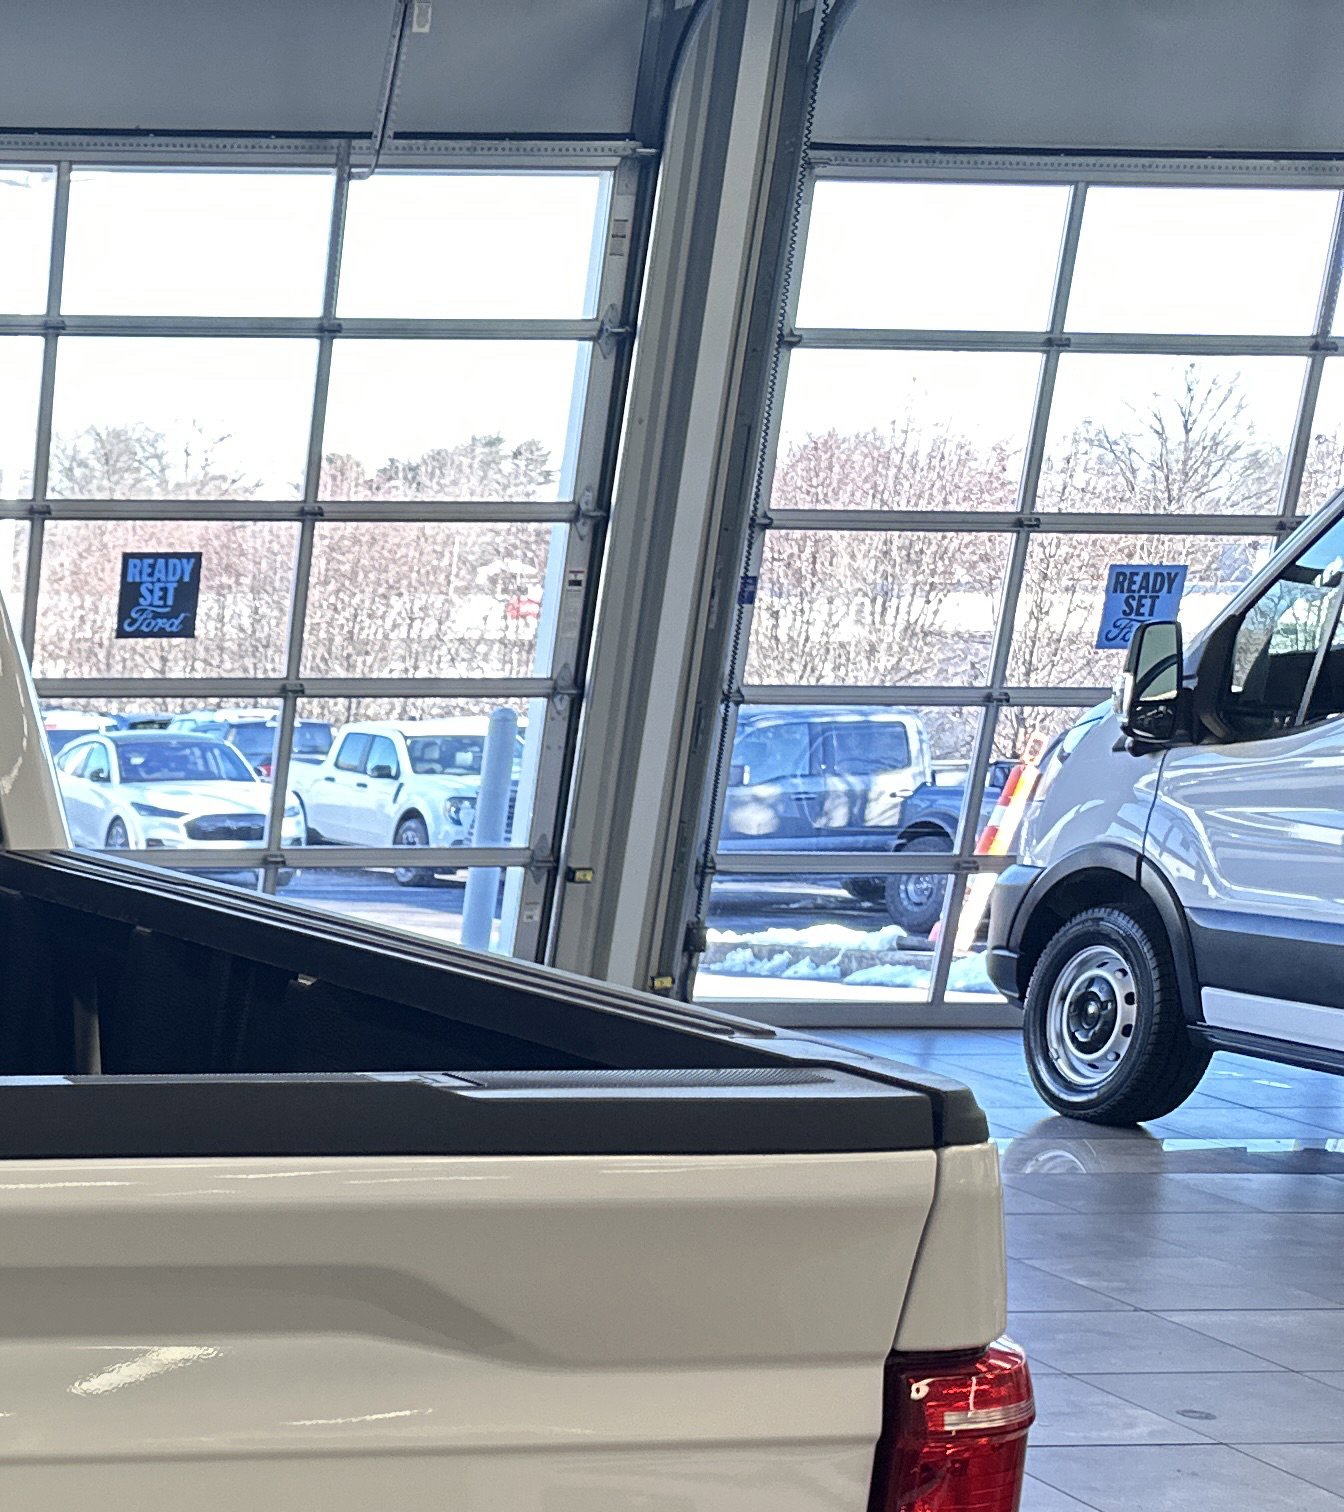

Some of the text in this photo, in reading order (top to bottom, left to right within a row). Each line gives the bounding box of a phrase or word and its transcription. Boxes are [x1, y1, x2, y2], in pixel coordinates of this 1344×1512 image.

[126, 558, 196, 582] READY
[139, 582, 178, 606] SET
[1112, 571, 1180, 594] READY
[1121, 595, 1160, 617] SET
[123, 605, 187, 633] Ford
[1105, 617, 1151, 643] Fo
